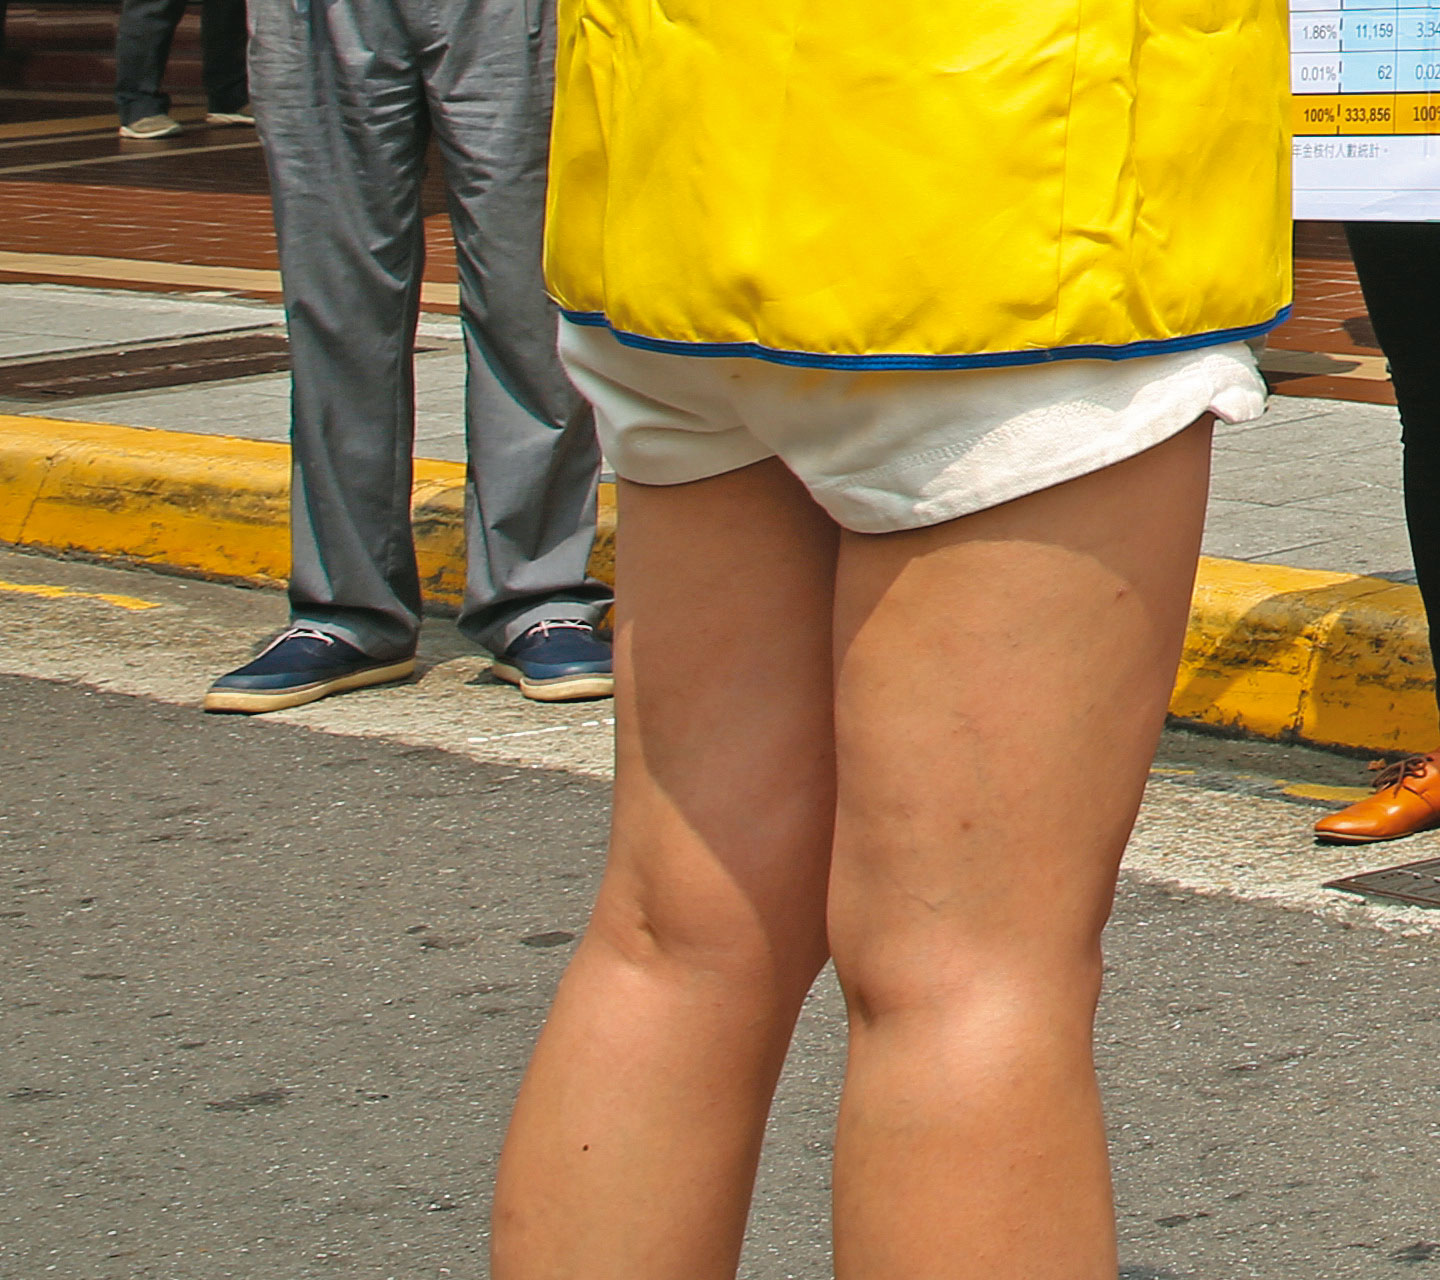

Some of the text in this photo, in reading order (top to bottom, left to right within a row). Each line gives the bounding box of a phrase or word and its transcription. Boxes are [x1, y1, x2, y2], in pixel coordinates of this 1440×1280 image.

[1303, 24, 1337, 40] 1.86%
[1355, 23, 1393, 39] 11,159
[1301, 66, 1336, 81] 0.01%
[1378, 65, 1392, 80] 62
[1304, 107, 1335, 123] 100%
[1345, 107, 1391, 124] 333,856
